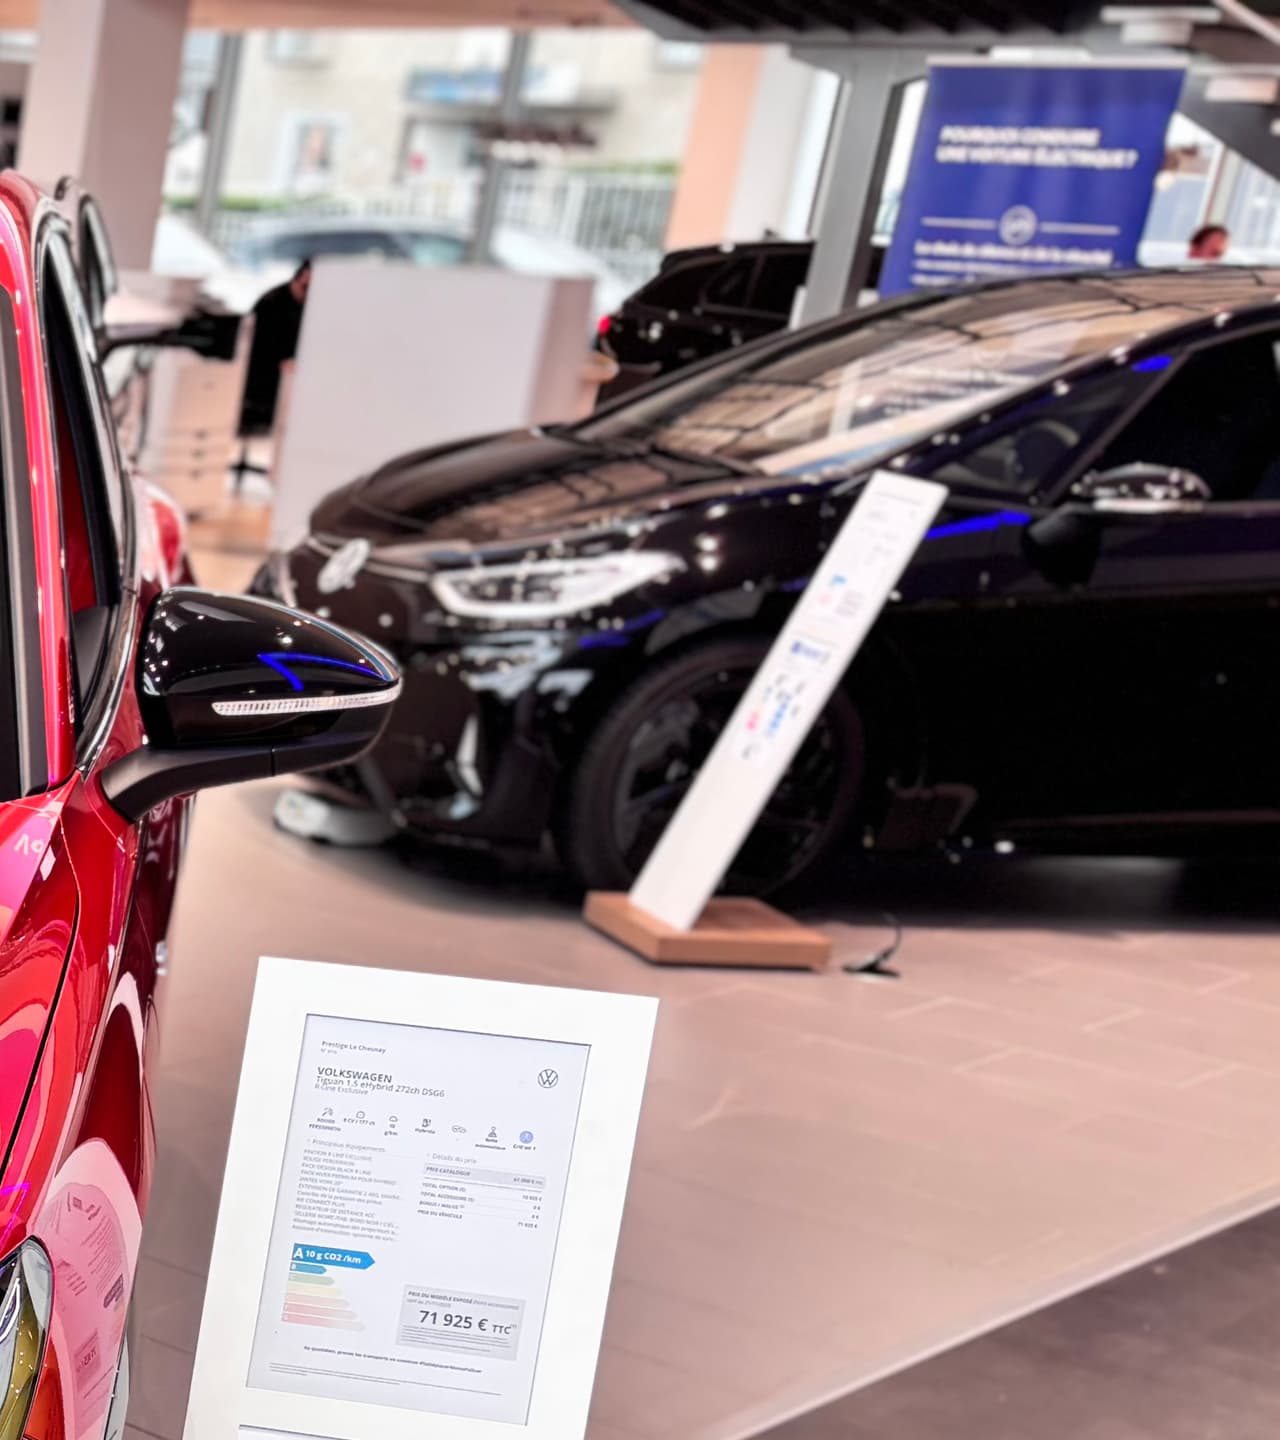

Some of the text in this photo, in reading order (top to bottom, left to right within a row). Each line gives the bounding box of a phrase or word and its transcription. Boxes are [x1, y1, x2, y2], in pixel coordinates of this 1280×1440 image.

[316, 1066, 392, 1083] VOLKSWAGEN
[315, 1075, 445, 1097] Tiguan 1.5 eHybrid 272ch DSG6
[293, 1248, 303, 1259] A
[316, 1252, 322, 1260] g
[324, 1252, 341, 1261] CO2
[343, 1255, 361, 1264] /km
[417, 1309, 511, 1334] 71 925 € TTC
